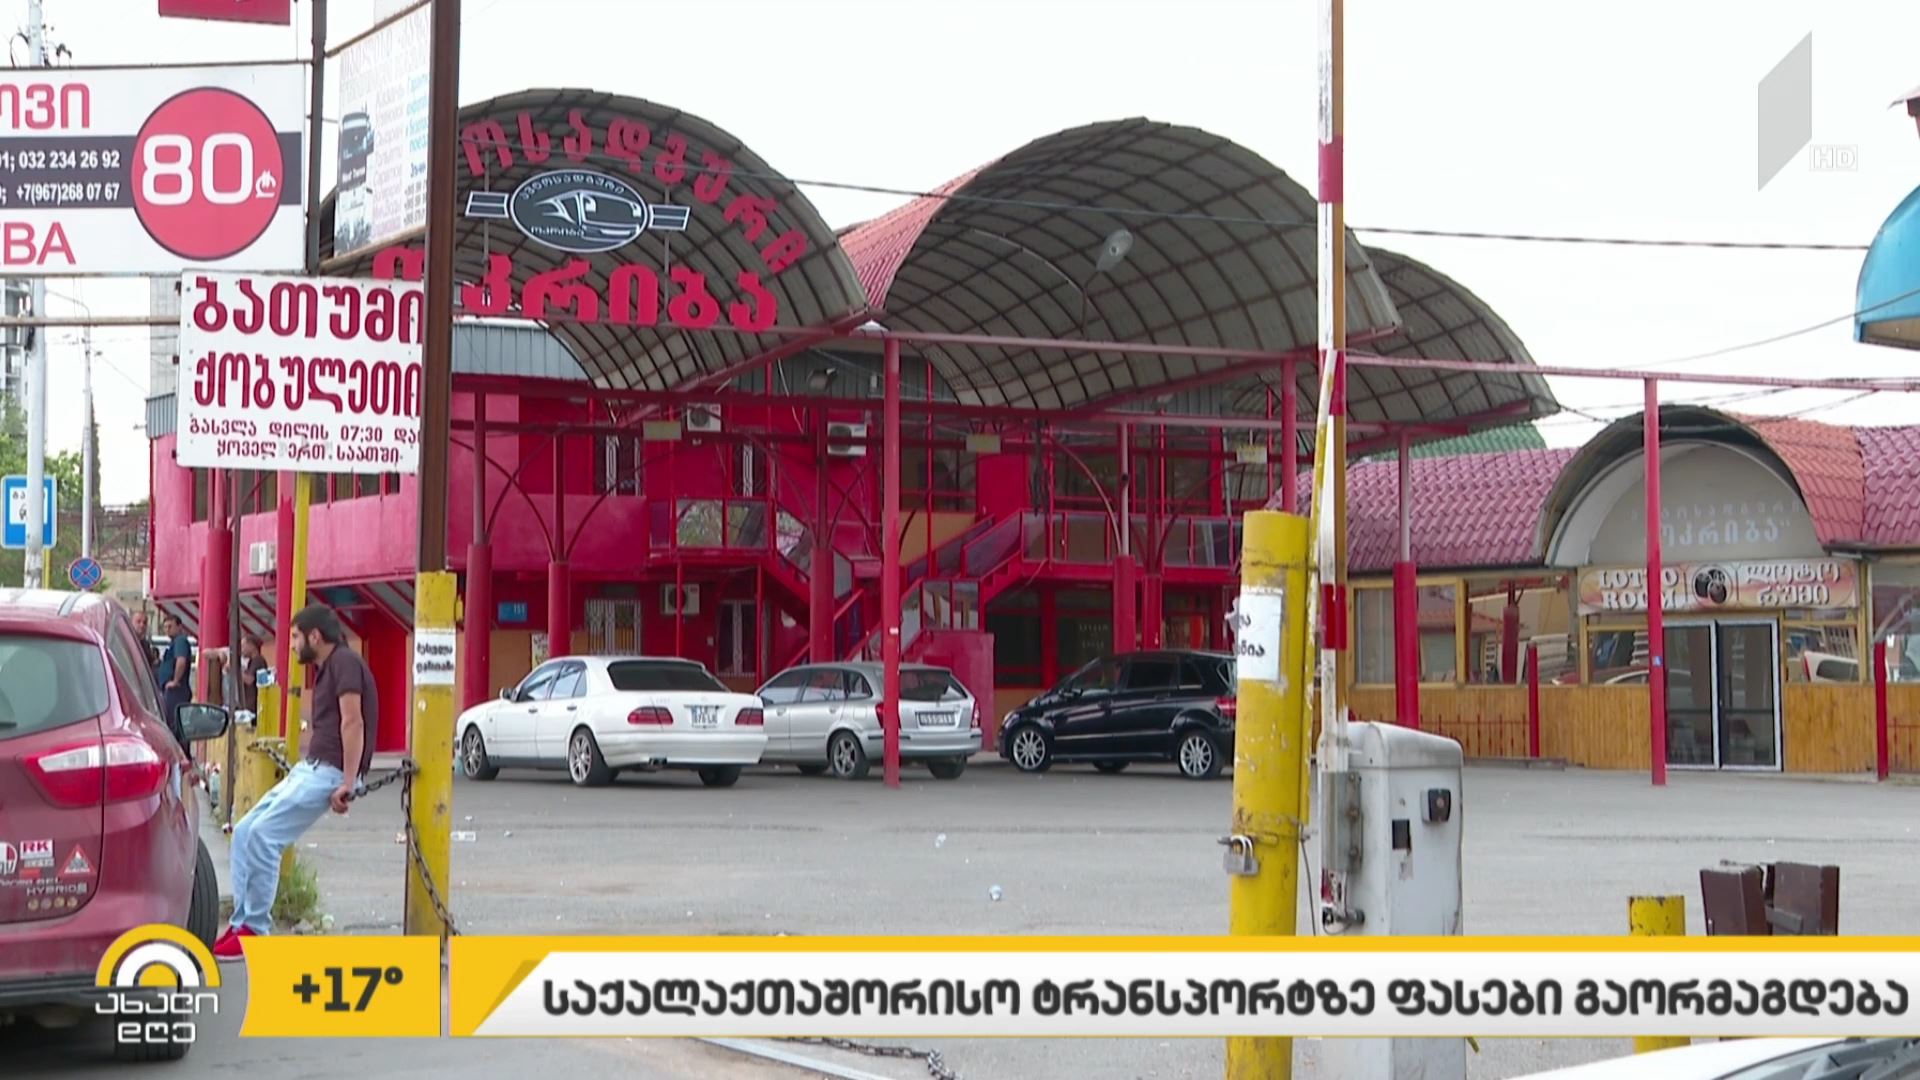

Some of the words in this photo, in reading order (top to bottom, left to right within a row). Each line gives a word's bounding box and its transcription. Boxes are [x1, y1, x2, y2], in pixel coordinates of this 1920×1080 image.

[18, 150, 46, 170] 032
[49, 150, 77, 169] 234
[80, 150, 99, 169] 26
[102, 150, 120, 169] 92
[86, 183, 102, 201] 07
[104, 183, 120, 201] 67
[0, 221, 76, 266] ВА
[193, 276, 424, 345] ბათუმი
[194, 350, 422, 418] ქობულეთი
[189, 417, 257, 437] გასვლა
[269, 421, 329, 440] დილის
[394, 427, 417, 444] და
[217, 438, 277, 457] ყოველ
[1602, 568, 1680, 589] LOTO
